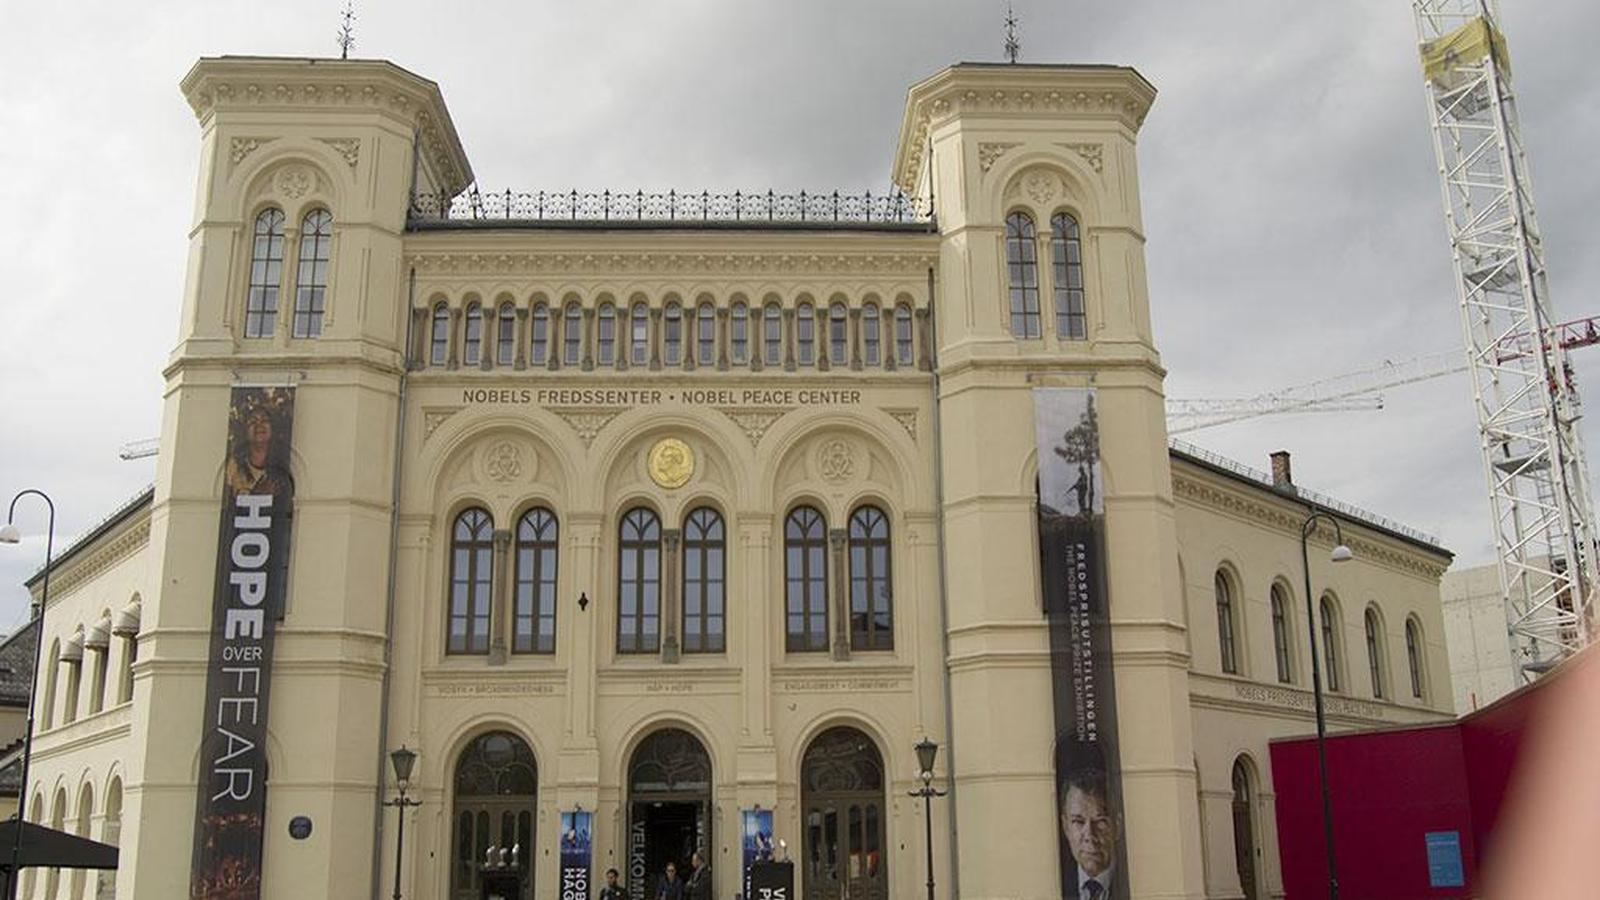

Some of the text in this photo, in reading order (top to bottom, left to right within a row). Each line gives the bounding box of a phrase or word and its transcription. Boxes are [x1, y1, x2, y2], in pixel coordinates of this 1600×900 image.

[463, 389, 861, 404] NOBELS FREDSSENTER NOBEL PEACE CENTER
[224, 493, 274, 640] HOPE
[1069, 605, 1080, 640] PEACE
[222, 646, 263, 661] OVER
[1071, 643, 1082, 677] PRIZE
[1076, 543, 1097, 742] FREDSPRISUTSTILLINGEN
[212, 666, 260, 802] FEAR
